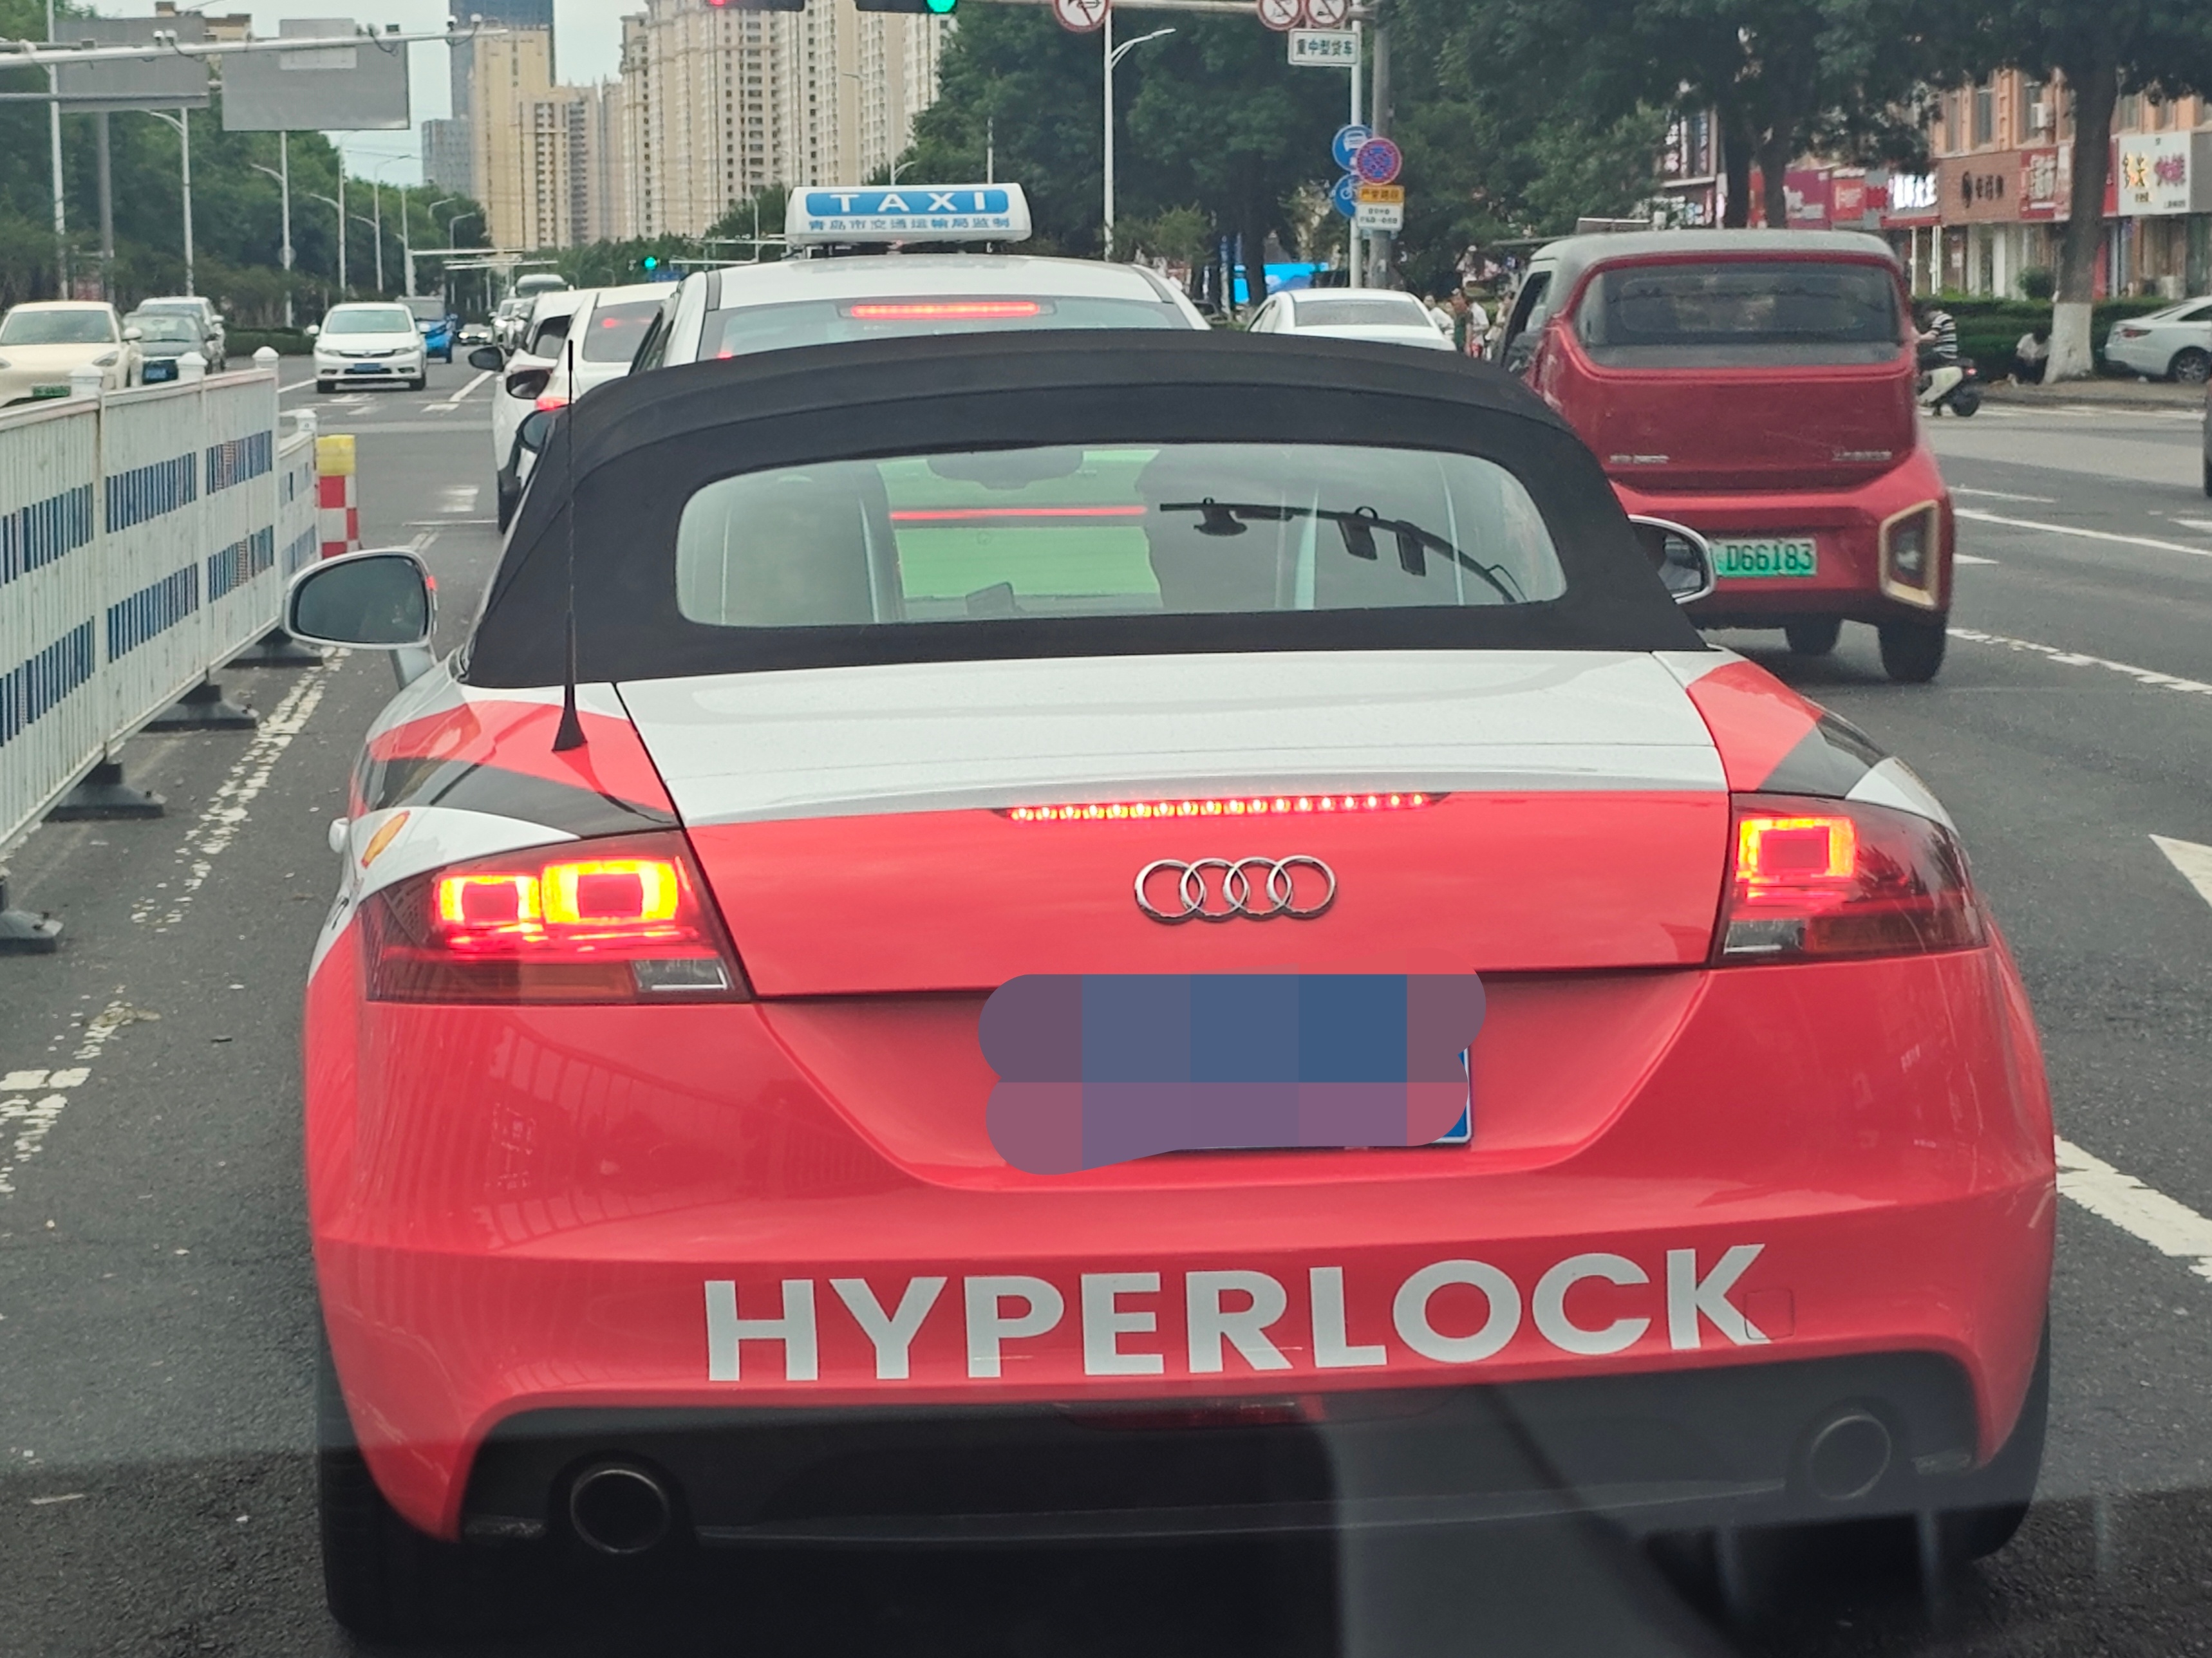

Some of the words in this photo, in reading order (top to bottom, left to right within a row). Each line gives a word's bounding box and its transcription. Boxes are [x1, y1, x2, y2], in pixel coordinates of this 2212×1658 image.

[829, 191, 986, 212] TAXI
[809, 218, 1010, 230] 青岛市交通运输局监制
[1726, 543, 1813, 571] D66183
[704, 1244, 1781, 1383] HYPERLOCK
